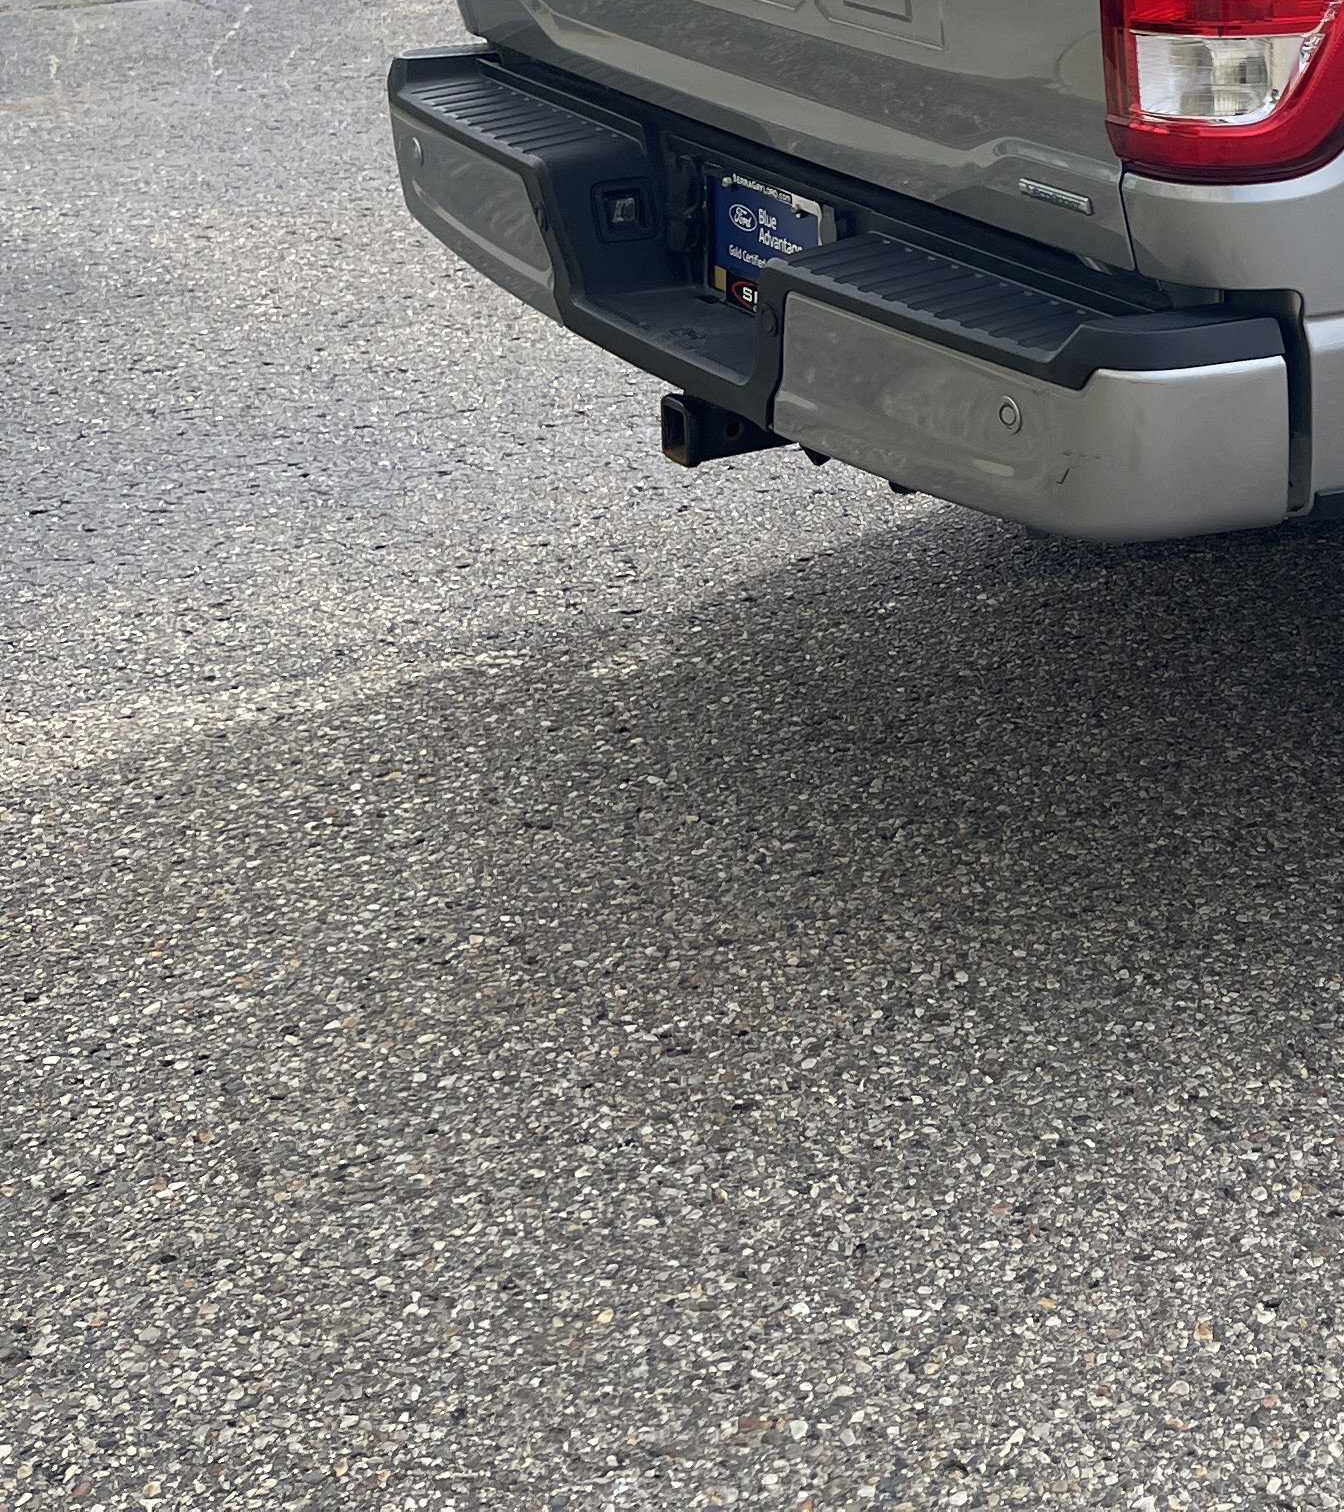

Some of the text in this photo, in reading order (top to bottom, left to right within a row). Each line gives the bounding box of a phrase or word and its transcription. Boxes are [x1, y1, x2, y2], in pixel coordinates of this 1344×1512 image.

[734, 207, 753, 228] Ford
[758, 208, 777, 230] Blue
[729, 244, 742, 260] Gold
